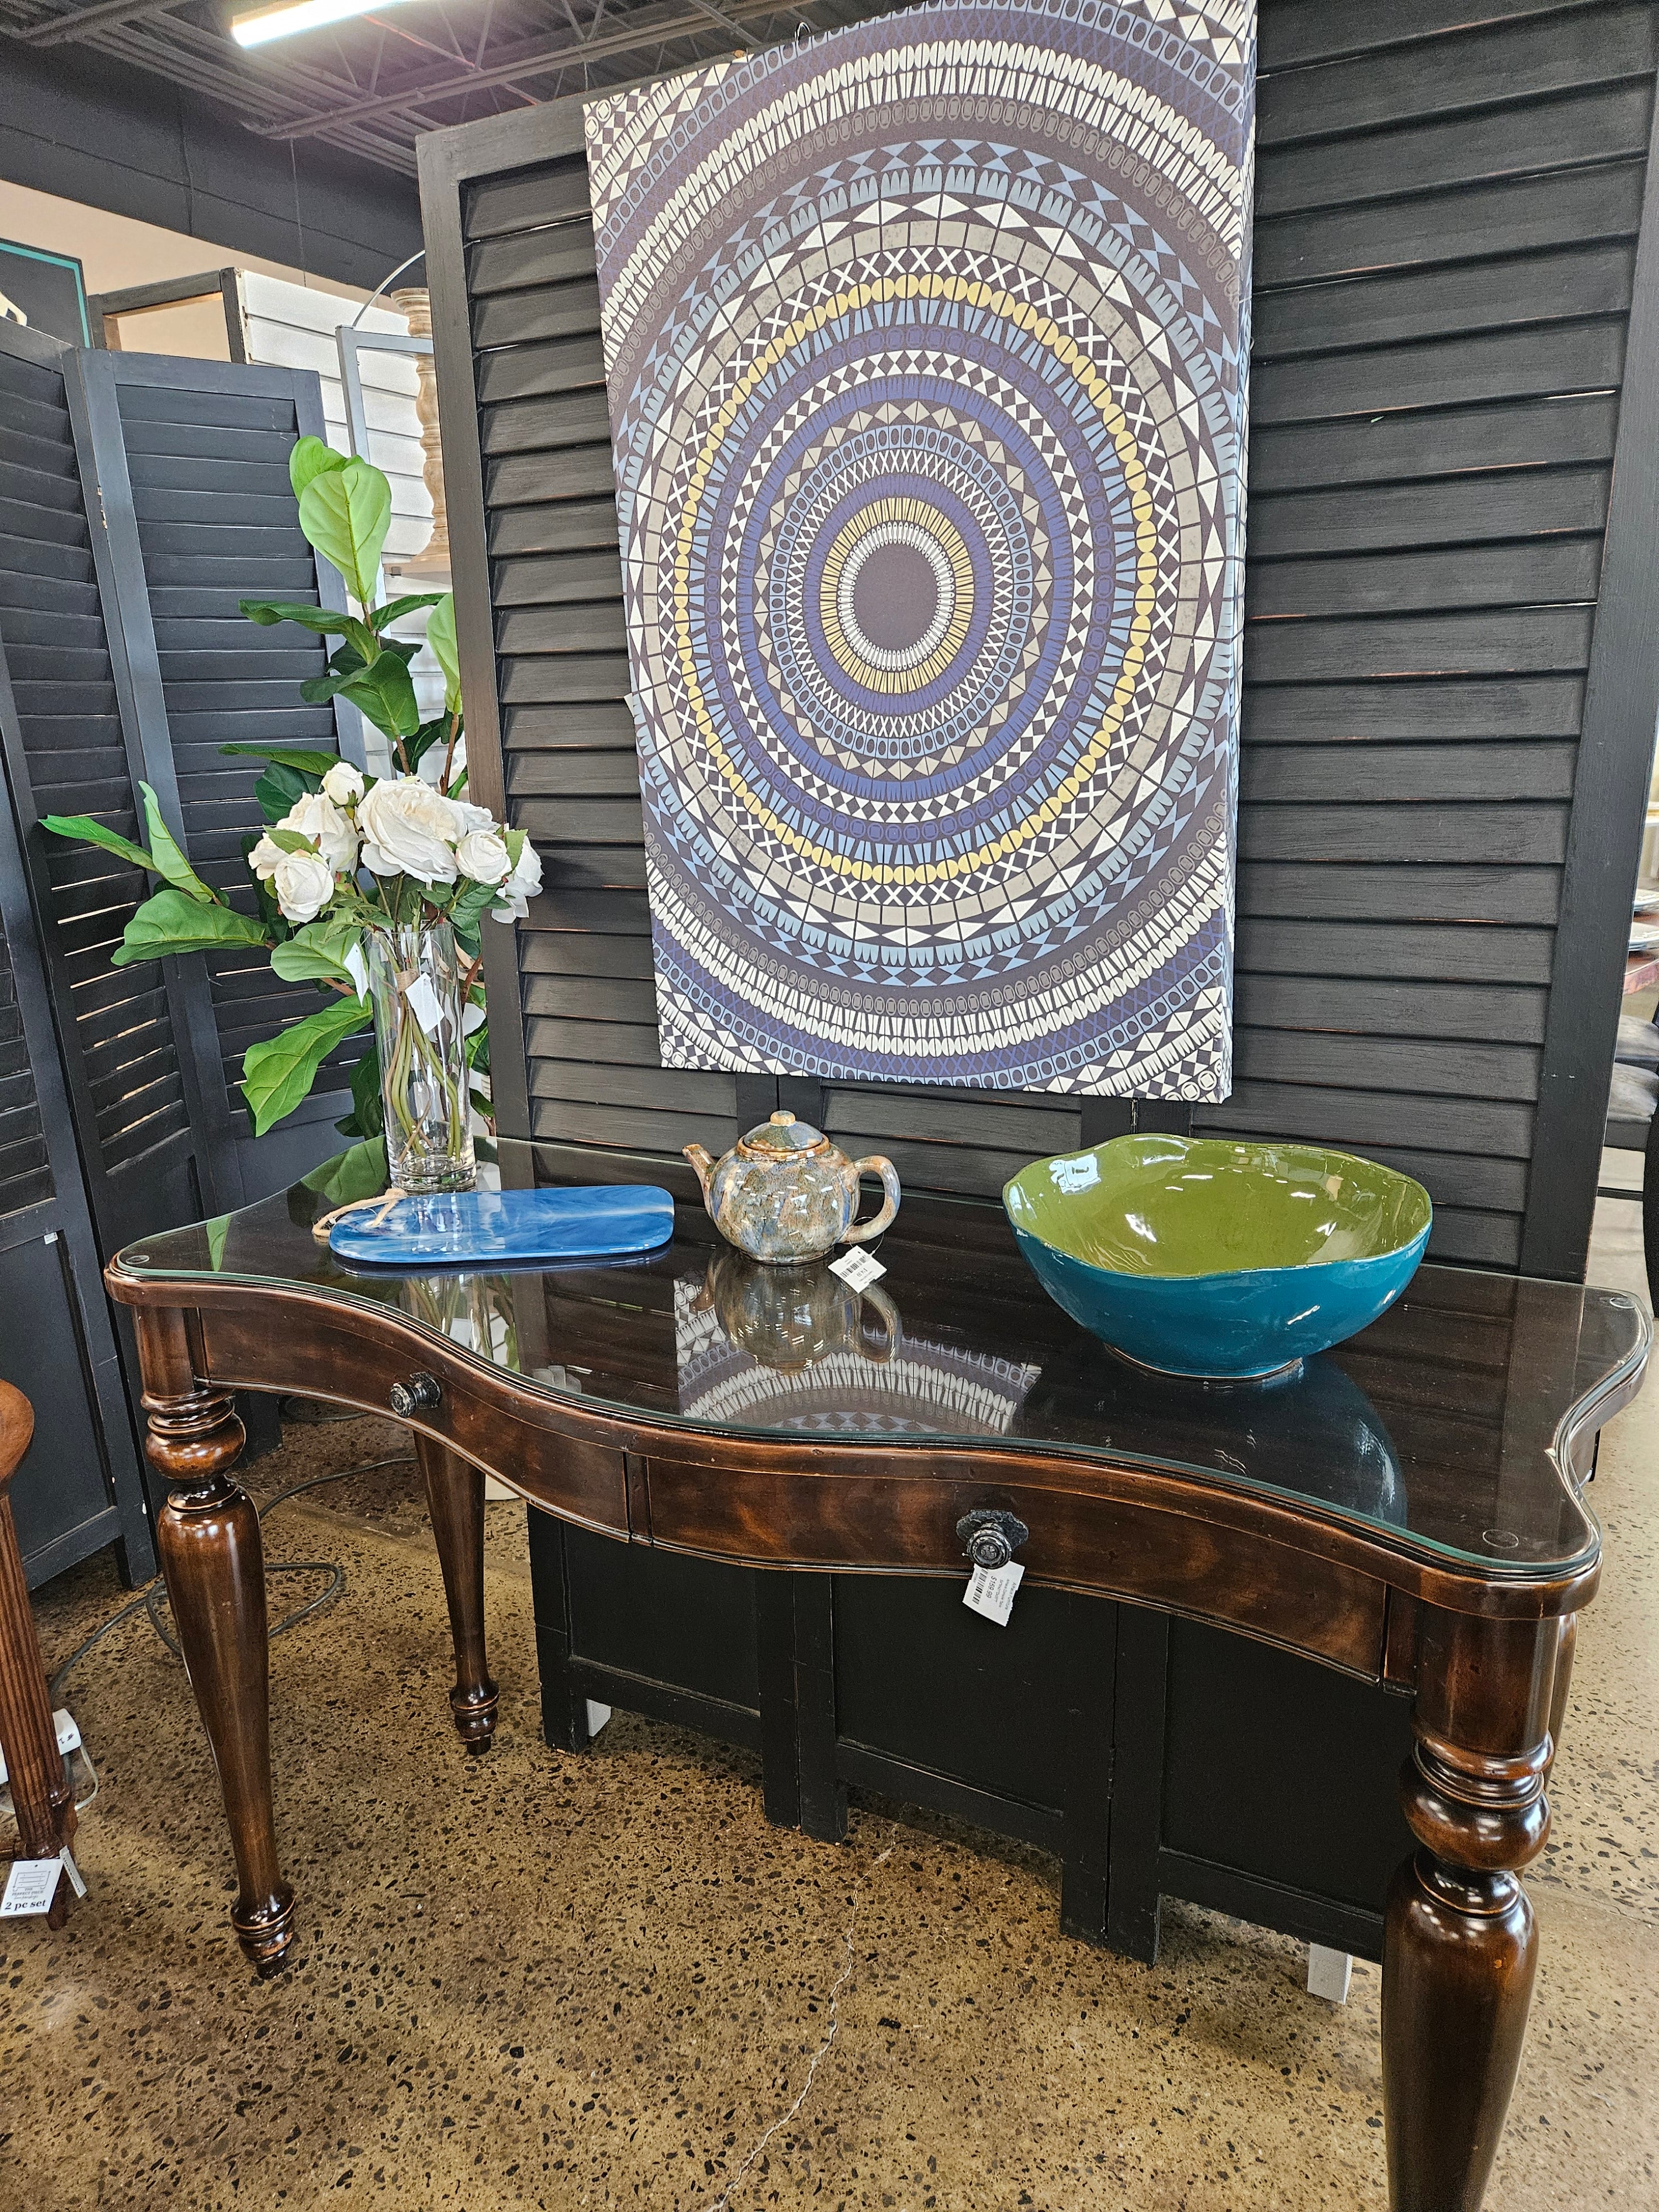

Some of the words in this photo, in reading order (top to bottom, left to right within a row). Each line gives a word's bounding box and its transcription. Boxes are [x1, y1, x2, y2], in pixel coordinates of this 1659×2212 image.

[985, 1575, 997, 1598] $159.99
[4, 1902, 12, 1910] 2
[14, 1902, 28, 1911] pc
